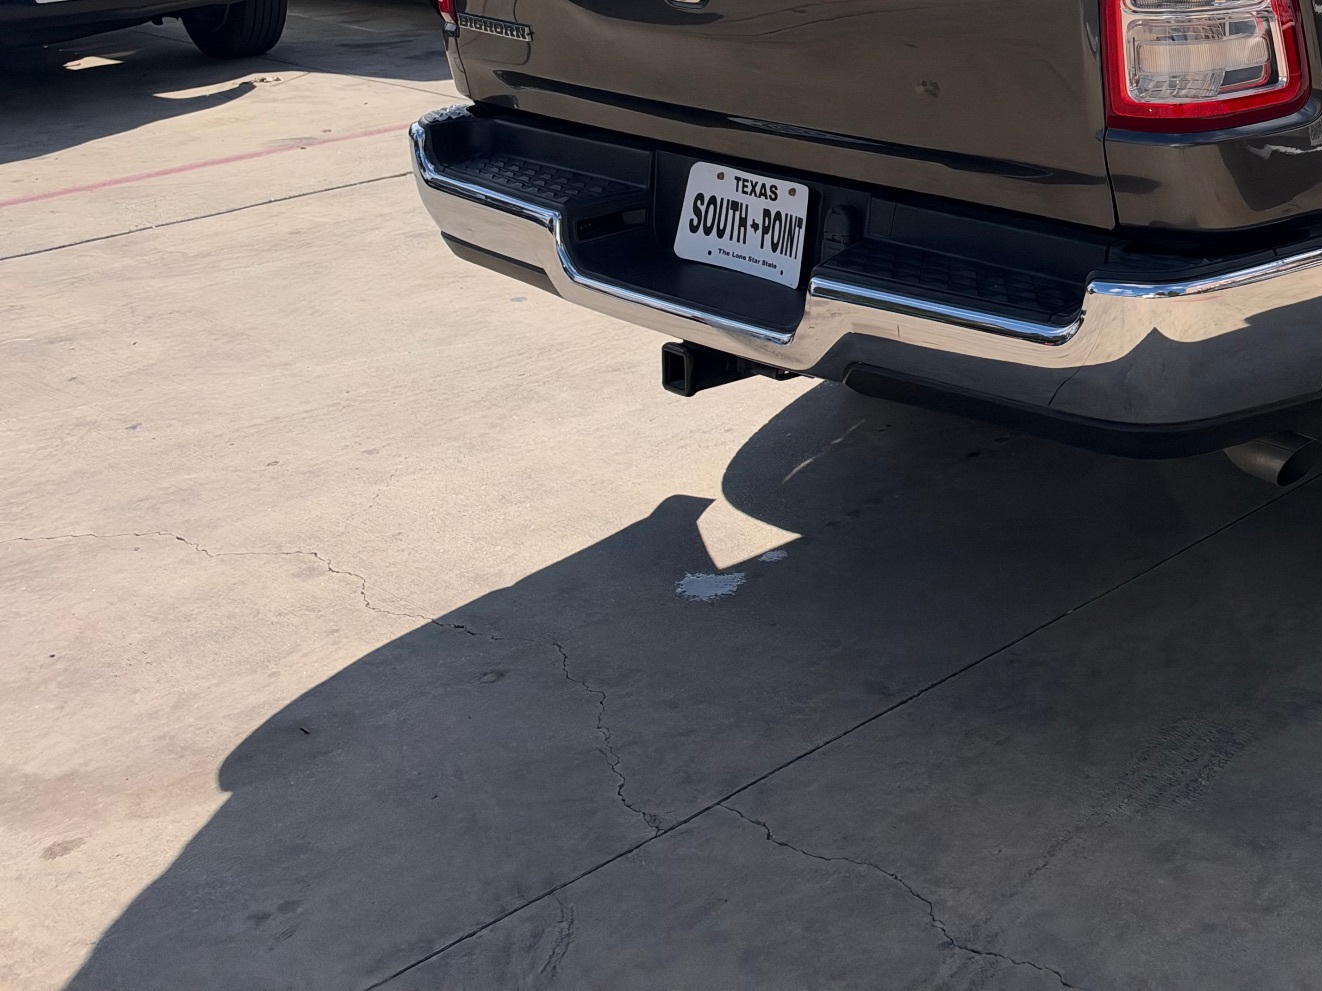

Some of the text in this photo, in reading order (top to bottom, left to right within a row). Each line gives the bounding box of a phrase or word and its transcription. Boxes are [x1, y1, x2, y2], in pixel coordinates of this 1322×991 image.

[459, 14, 528, 40] BIGHORN
[734, 175, 779, 202] TEXAS
[688, 192, 804, 260] SOUTH POINT
[717, 247, 778, 270] The Lone Star State
